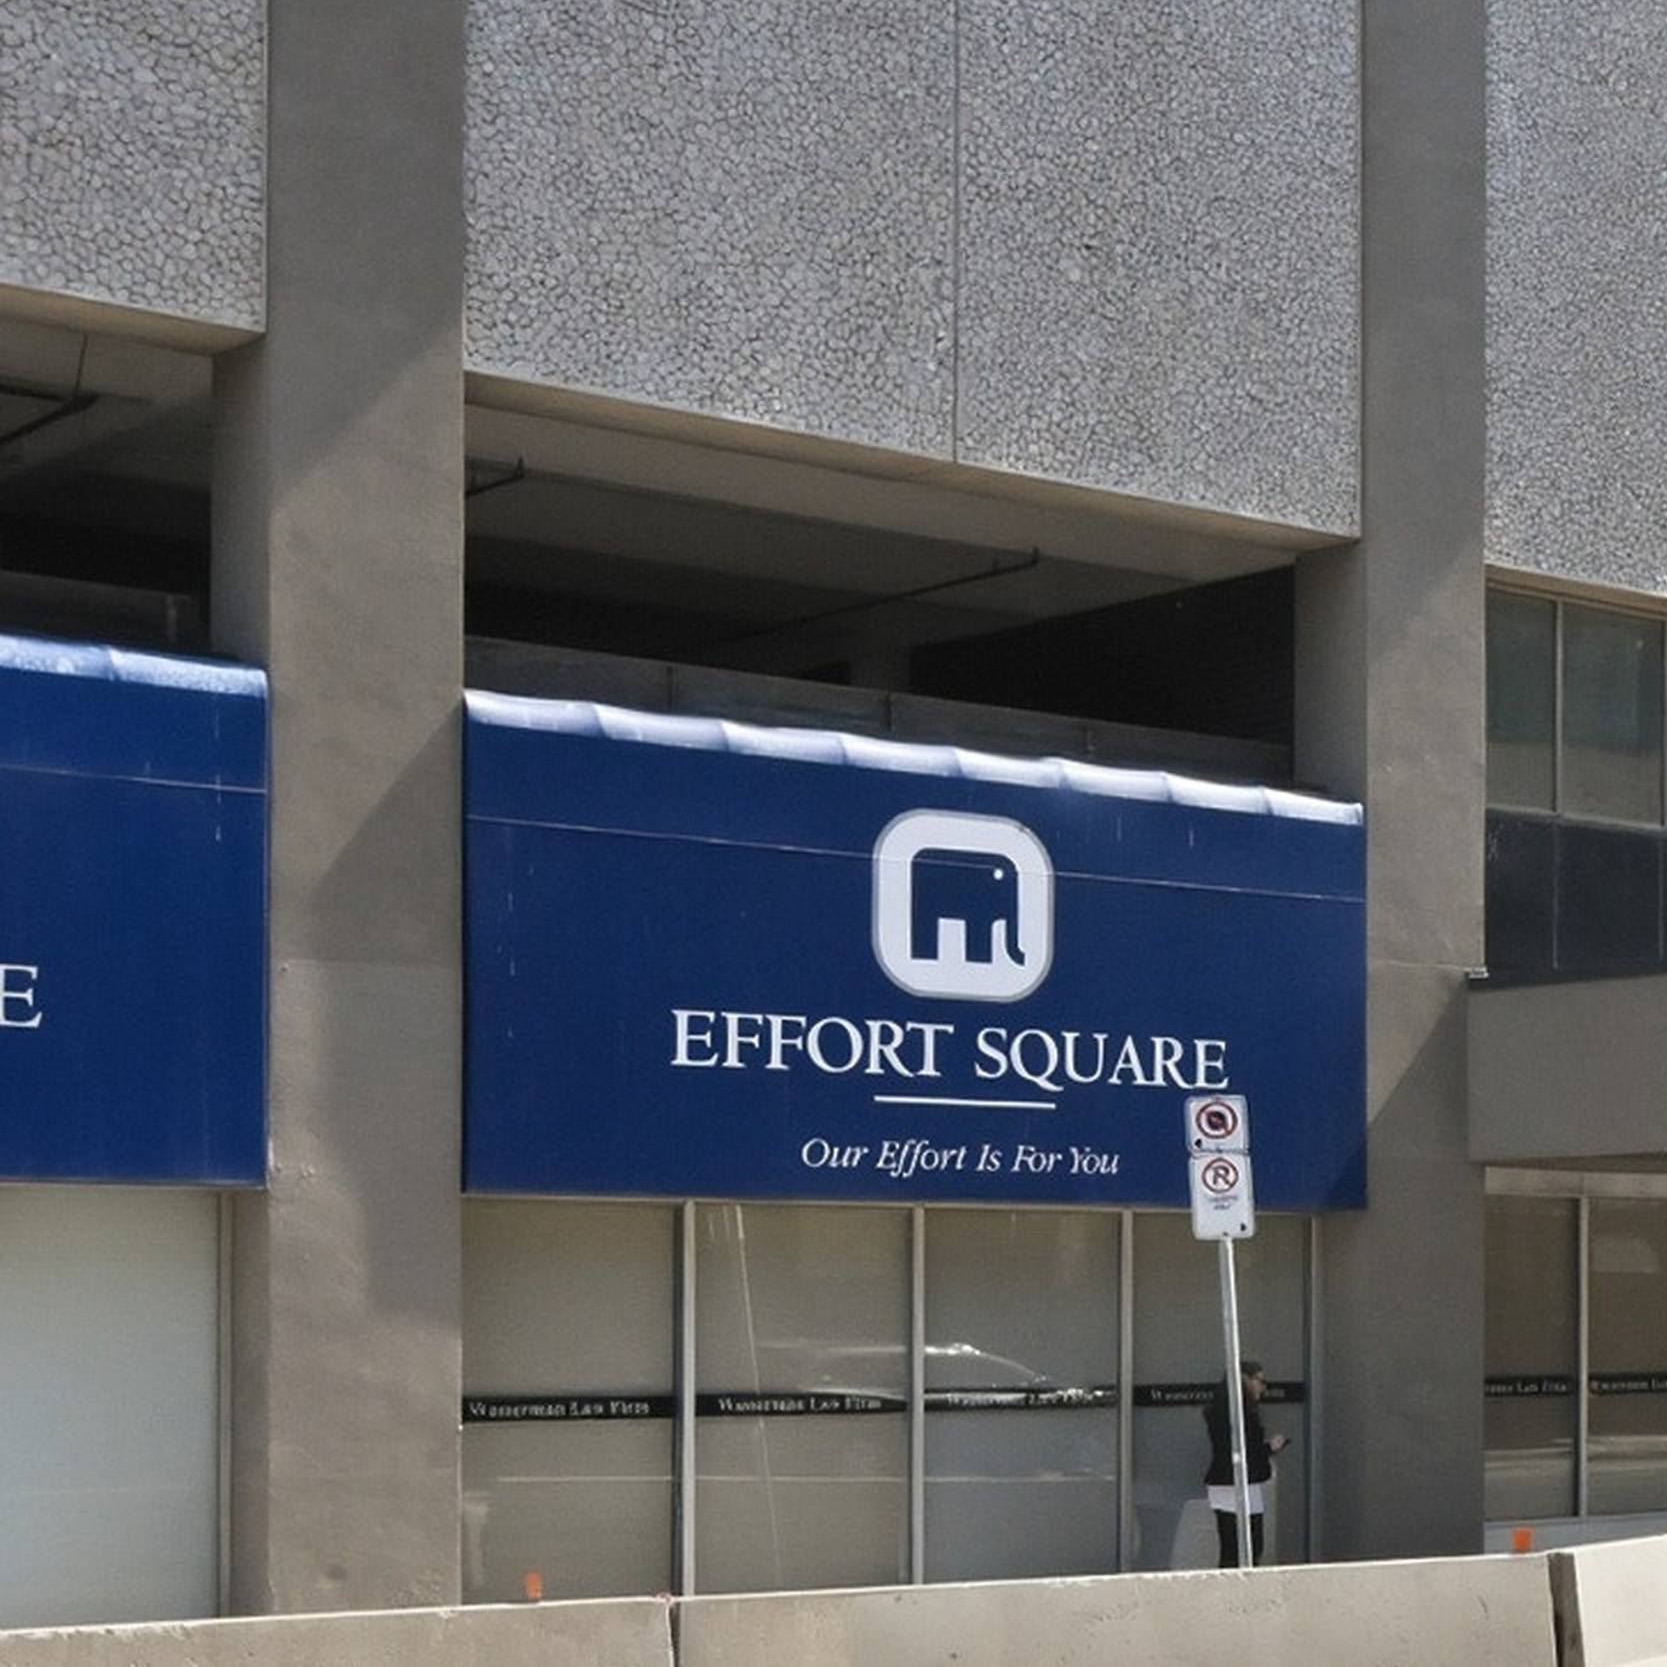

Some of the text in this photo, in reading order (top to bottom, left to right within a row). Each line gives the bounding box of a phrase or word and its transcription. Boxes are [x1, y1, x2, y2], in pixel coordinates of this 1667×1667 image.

[670, 1009, 1230, 1092] EFFORT SQUARE
[801, 1137, 1120, 1178] Our Effort Is For You
